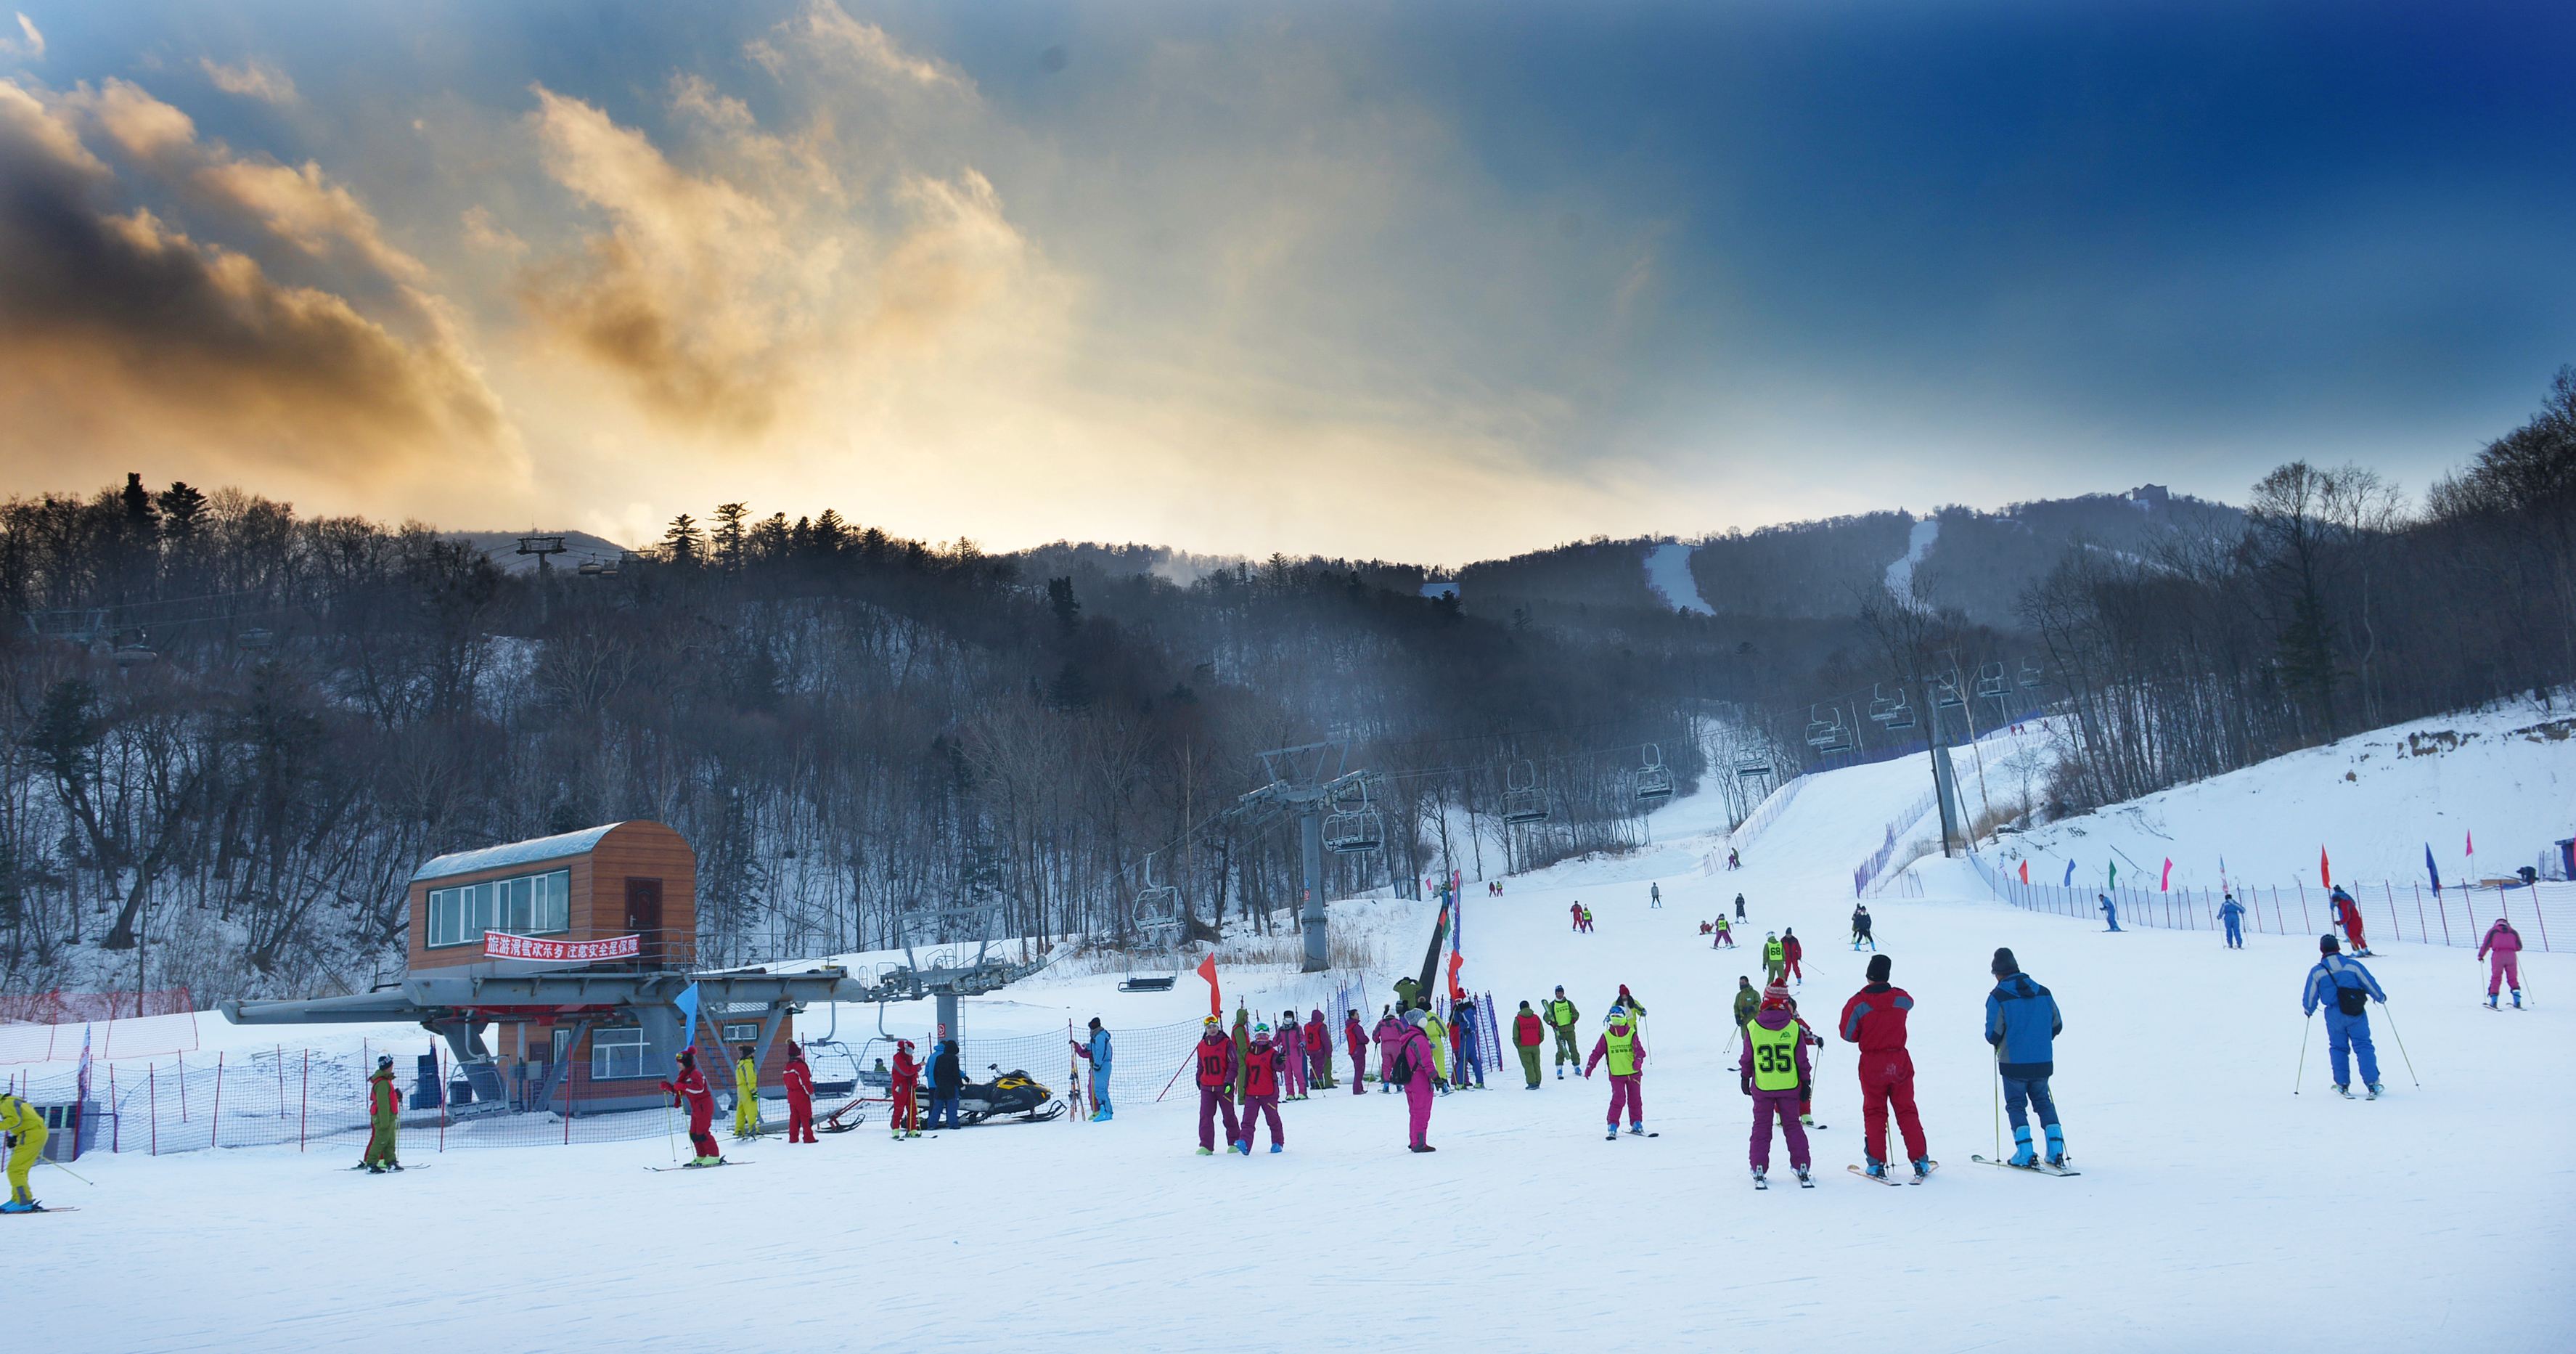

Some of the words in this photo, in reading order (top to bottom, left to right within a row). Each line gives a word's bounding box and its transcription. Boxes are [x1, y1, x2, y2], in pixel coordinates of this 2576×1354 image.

[487, 934, 563, 958] 旅游滑雪欢乐多
[567, 938, 638, 958] 注意安全是保障
[1770, 947, 1781, 955] 68
[1204, 1056, 1220, 1075] 10
[1757, 1043, 1792, 1073] 35
[1251, 1065, 1260, 1085] 7
